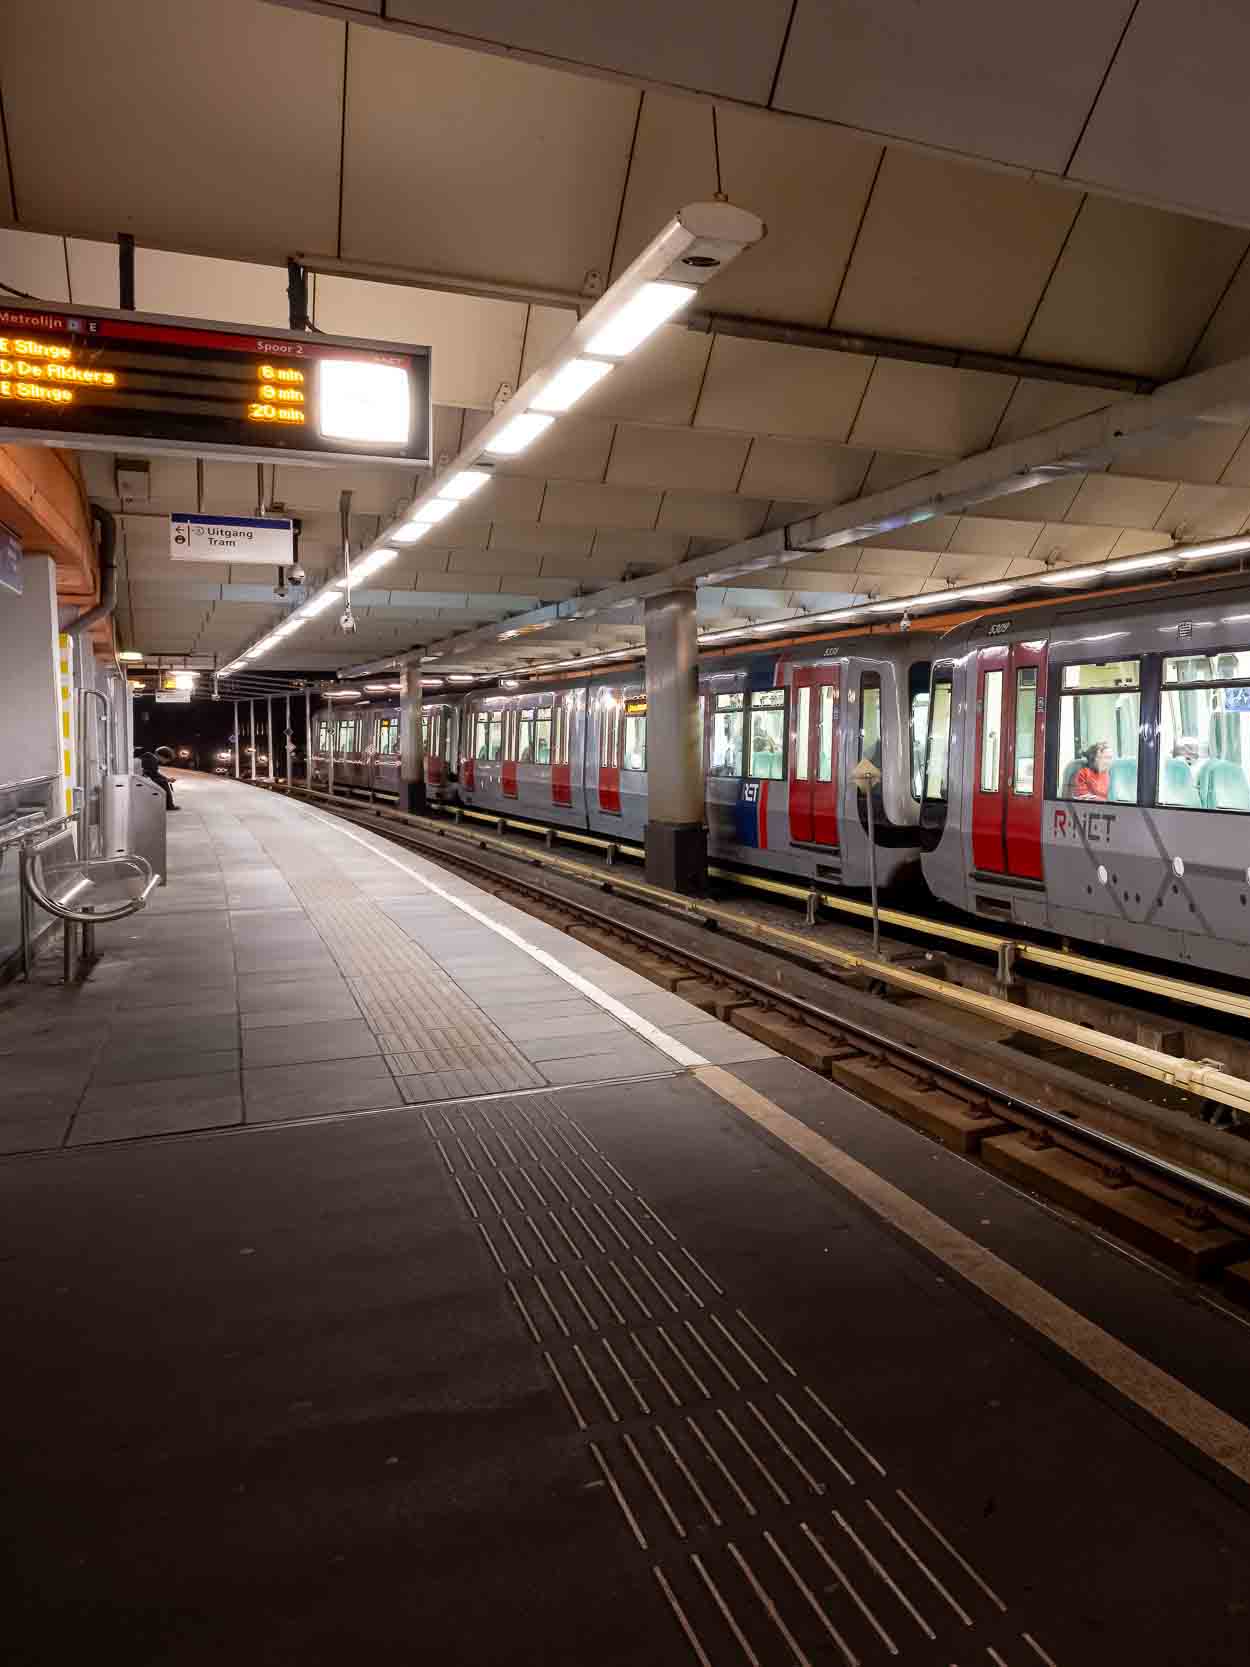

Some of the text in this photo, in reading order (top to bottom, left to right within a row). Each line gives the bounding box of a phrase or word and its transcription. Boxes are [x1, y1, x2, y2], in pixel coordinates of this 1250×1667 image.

[0, 312, 62, 329] Metrolijn
[15, 340, 71, 359] Slinge
[256, 341, 305, 354] Spoor 2
[16, 361, 42, 377] De
[277, 370, 304, 382] min
[16, 383, 72, 401] Slinge
[277, 389, 304, 402] min
[250, 404, 305, 421] 20 min
[207, 527, 254, 540] Uitgang
[208, 537, 236, 547] Tram
[744, 783, 760, 802] RET
